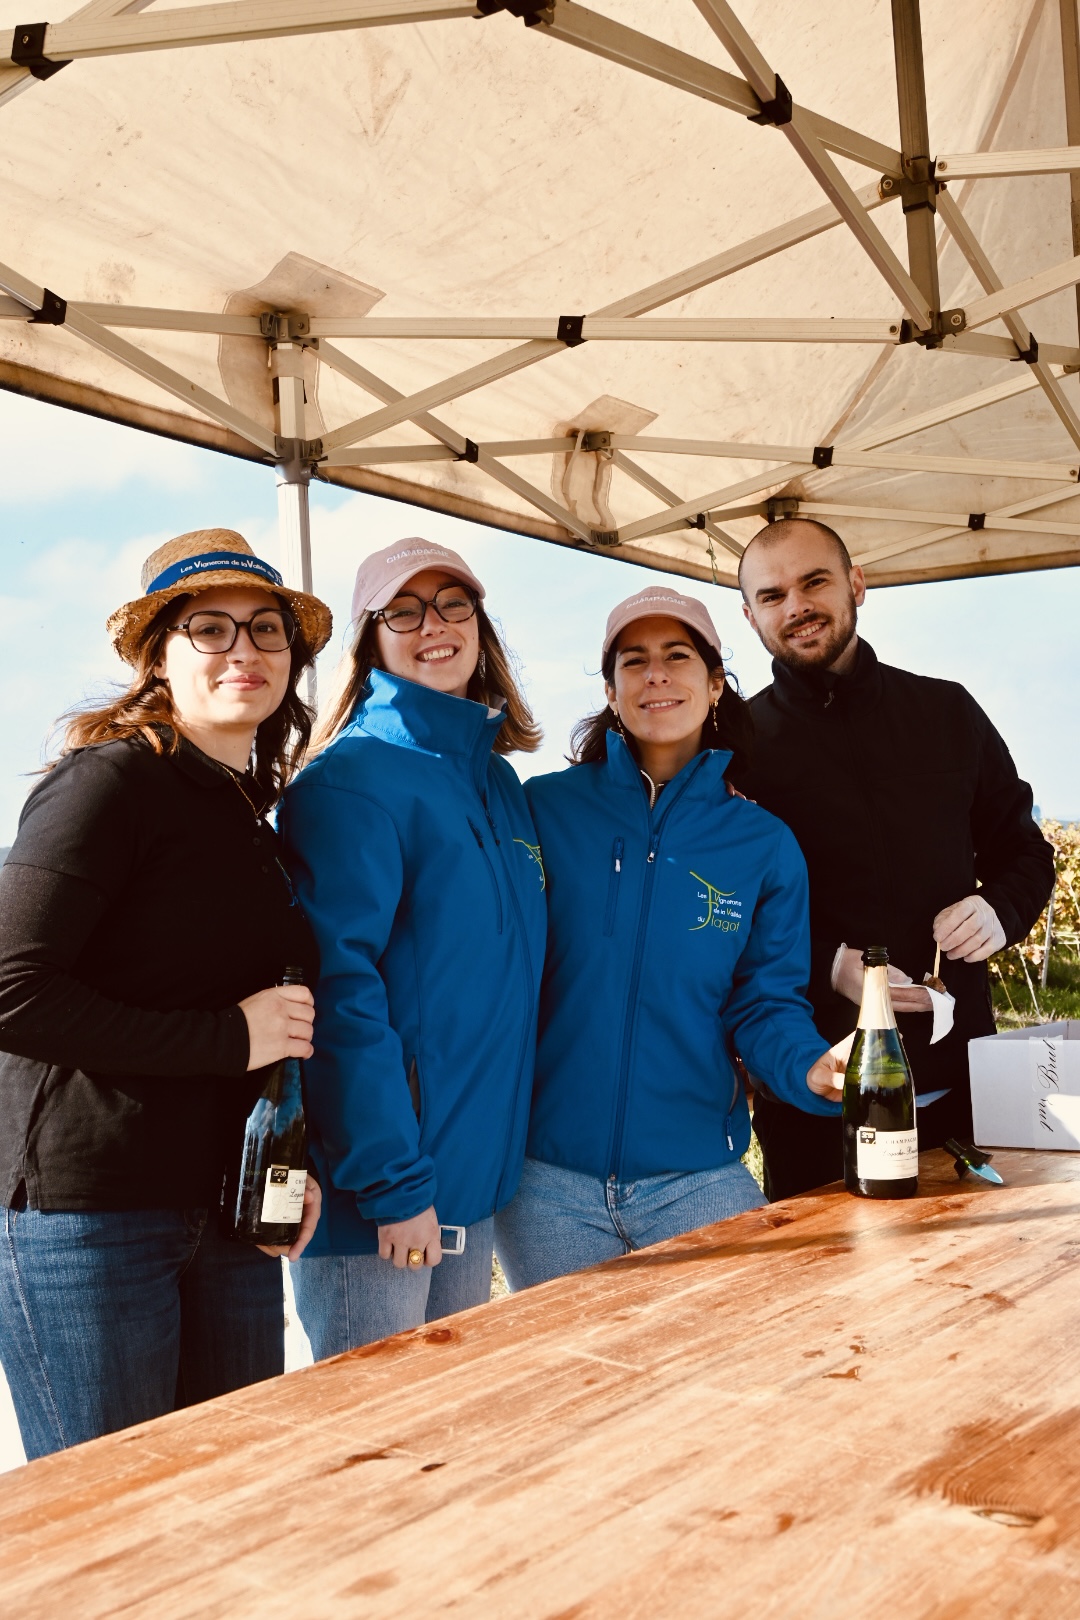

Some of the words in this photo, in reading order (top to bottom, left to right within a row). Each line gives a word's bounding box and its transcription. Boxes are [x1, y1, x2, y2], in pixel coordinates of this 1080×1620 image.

[386, 548, 450, 564] CHAMPAGNE
[180, 565, 193, 573] Les
[194, 560, 230, 569] Vignerons
[697, 891, 708, 899] Les
[714, 892, 742, 907] Vignerons
